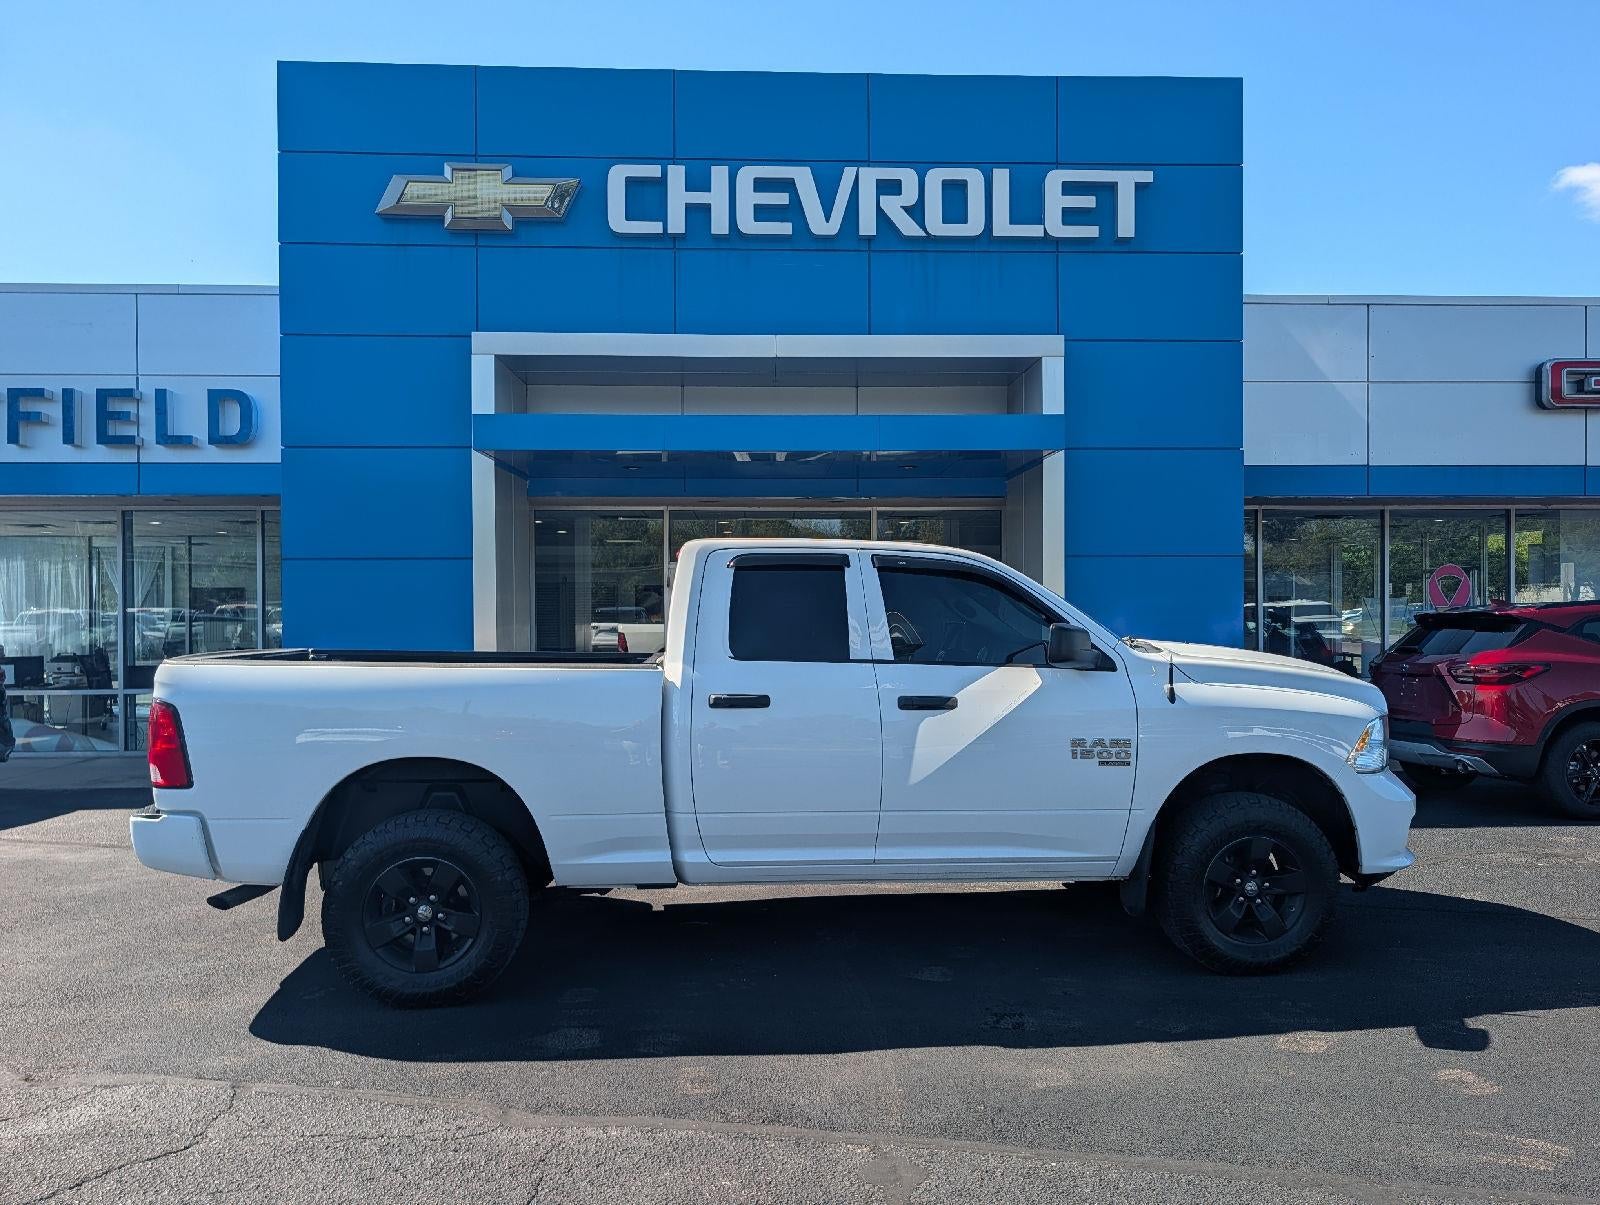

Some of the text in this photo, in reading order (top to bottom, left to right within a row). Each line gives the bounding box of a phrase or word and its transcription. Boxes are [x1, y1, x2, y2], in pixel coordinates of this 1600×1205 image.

[607, 164, 1154, 239] CHEVROLET
[6, 387, 260, 446] FIELD
[1069, 737, 1132, 748] RAM
[1070, 749, 1132, 760] 1500
